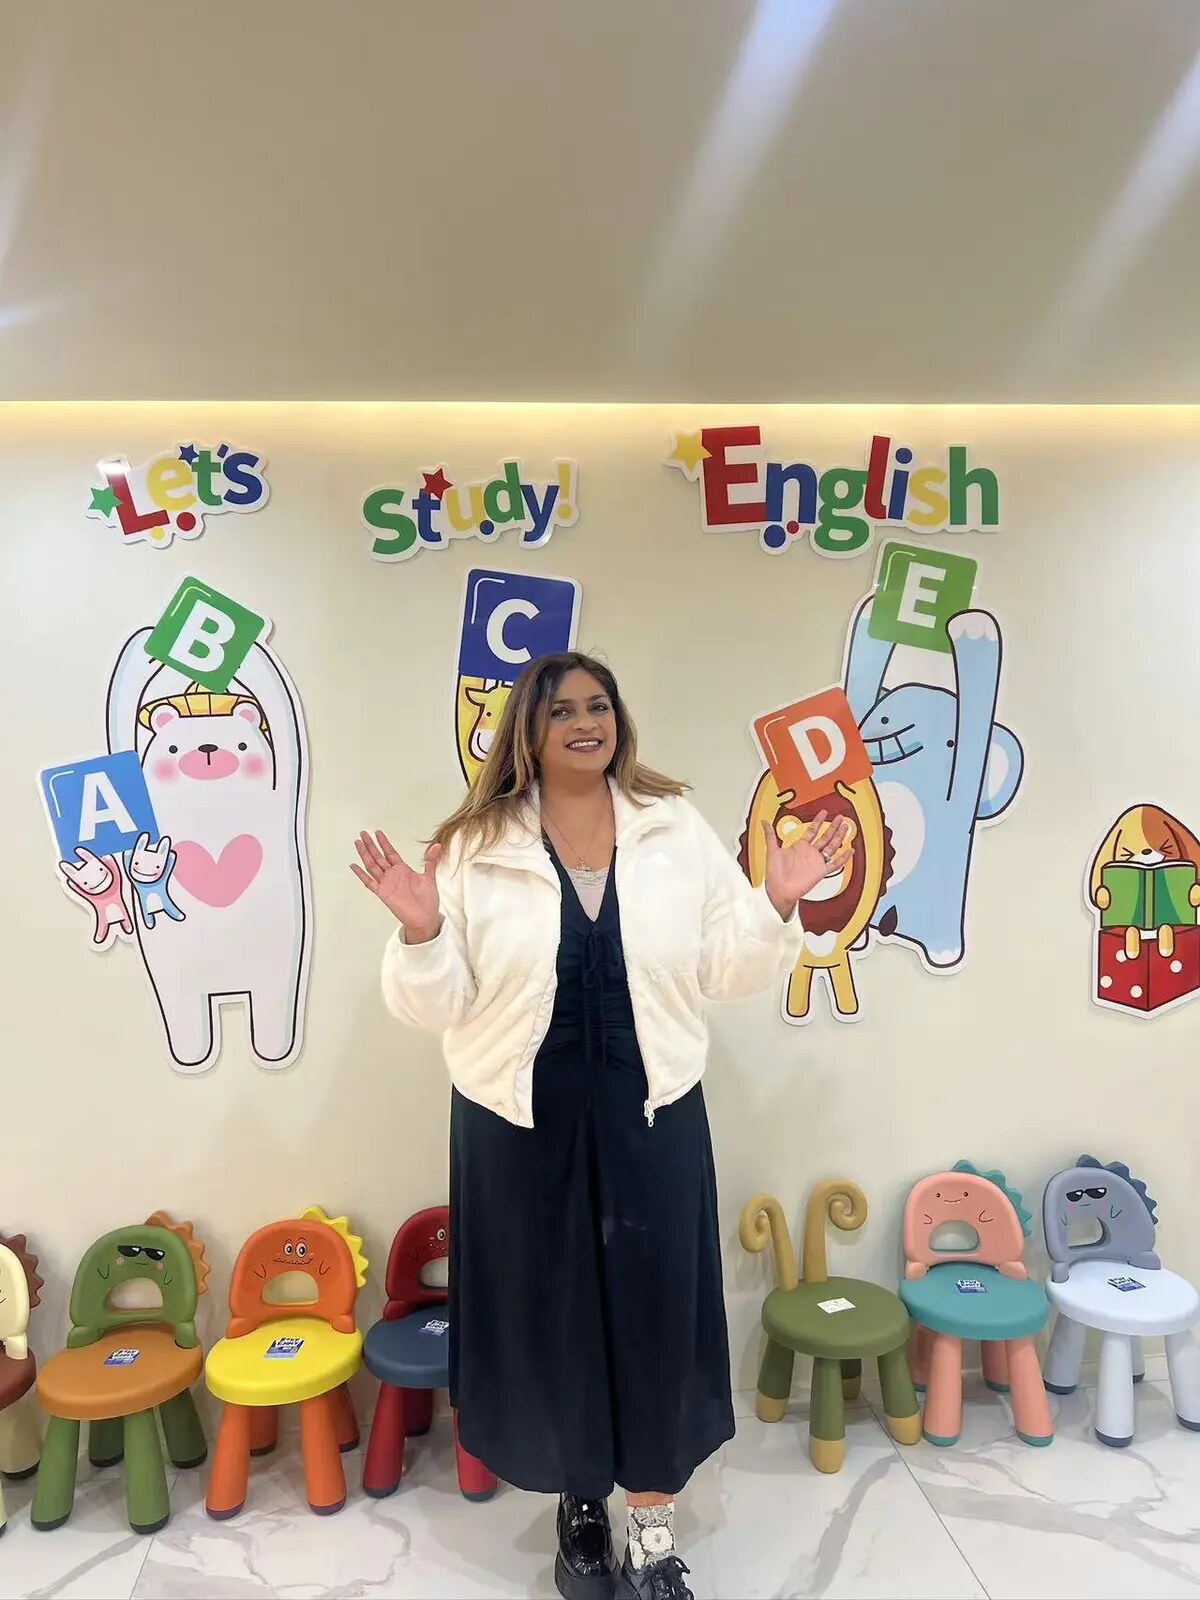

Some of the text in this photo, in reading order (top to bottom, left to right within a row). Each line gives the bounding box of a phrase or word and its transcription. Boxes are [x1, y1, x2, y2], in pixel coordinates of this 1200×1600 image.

[102, 425, 999, 555] Let's Study! English
[896, 562, 947, 629] E
[168, 599, 235, 673] B
[485, 598, 541, 665] C
[787, 715, 846, 781] D
[78, 771, 138, 842] A
